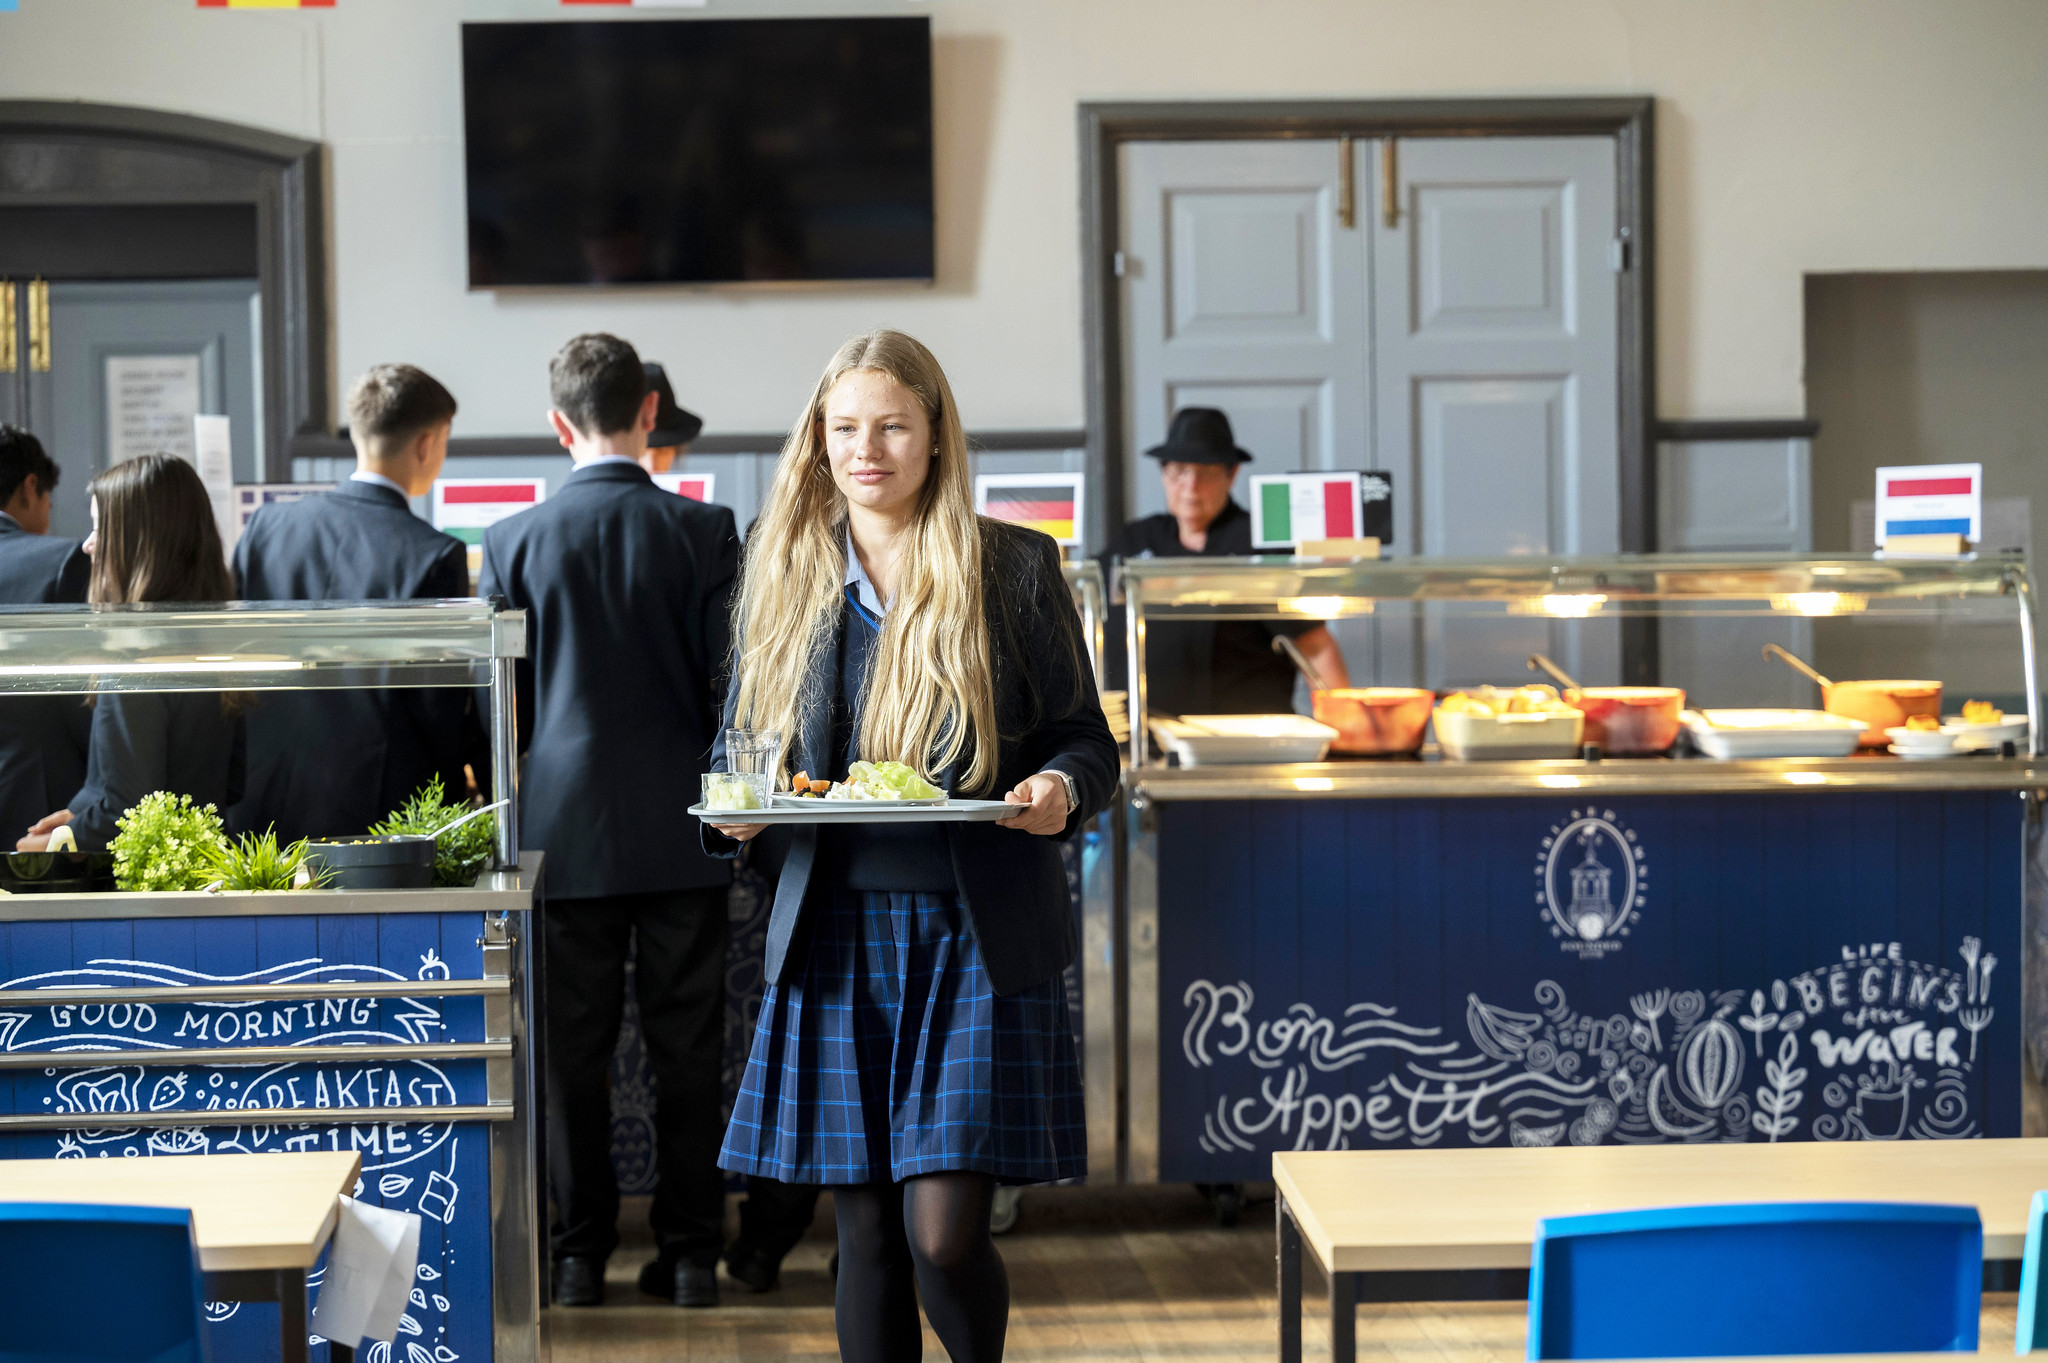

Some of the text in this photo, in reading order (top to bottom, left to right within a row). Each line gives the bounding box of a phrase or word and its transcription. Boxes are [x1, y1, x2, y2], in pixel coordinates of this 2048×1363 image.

[1841, 941, 1901, 960] LIFE
[1795, 965, 1963, 1015] BEGINS
[50, 998, 378, 1043] GOOD MORNING
[1842, 1006, 1911, 1030] after
[286, 1121, 412, 1156] TIME
